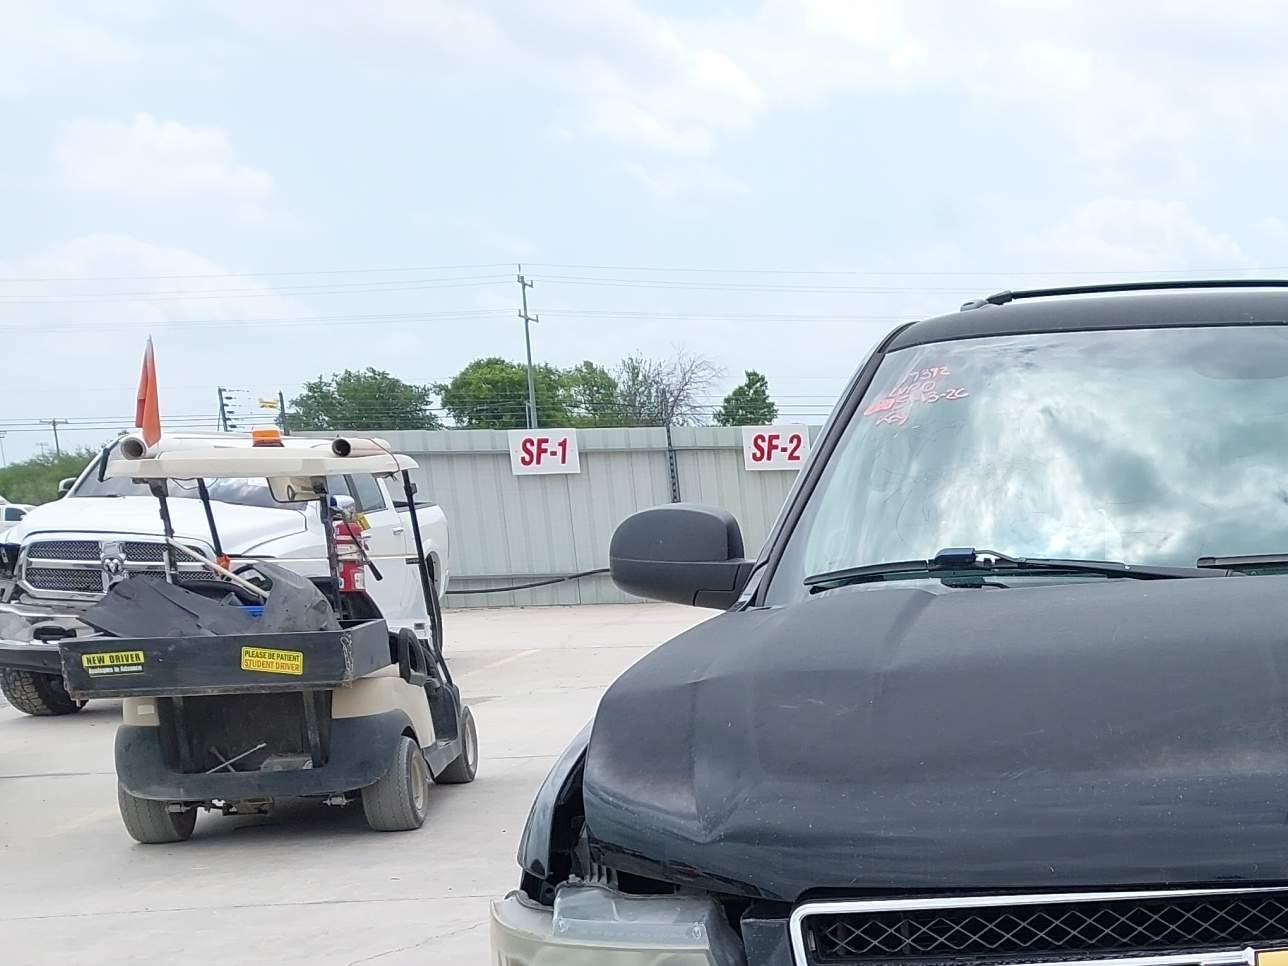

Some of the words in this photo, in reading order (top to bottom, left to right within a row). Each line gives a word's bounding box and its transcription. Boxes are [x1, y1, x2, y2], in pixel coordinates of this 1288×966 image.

[520, 437, 568, 467] SF-1
[751, 434, 802, 462] SF-2
[86, 654, 105, 666] NEW
[109, 652, 142, 664] DRIVER
[244, 650, 267, 659] PLEASE
[276, 653, 300, 662] PATIENT
[244, 659, 274, 669] STUDENT
[275, 662, 300, 671] DRIVER
